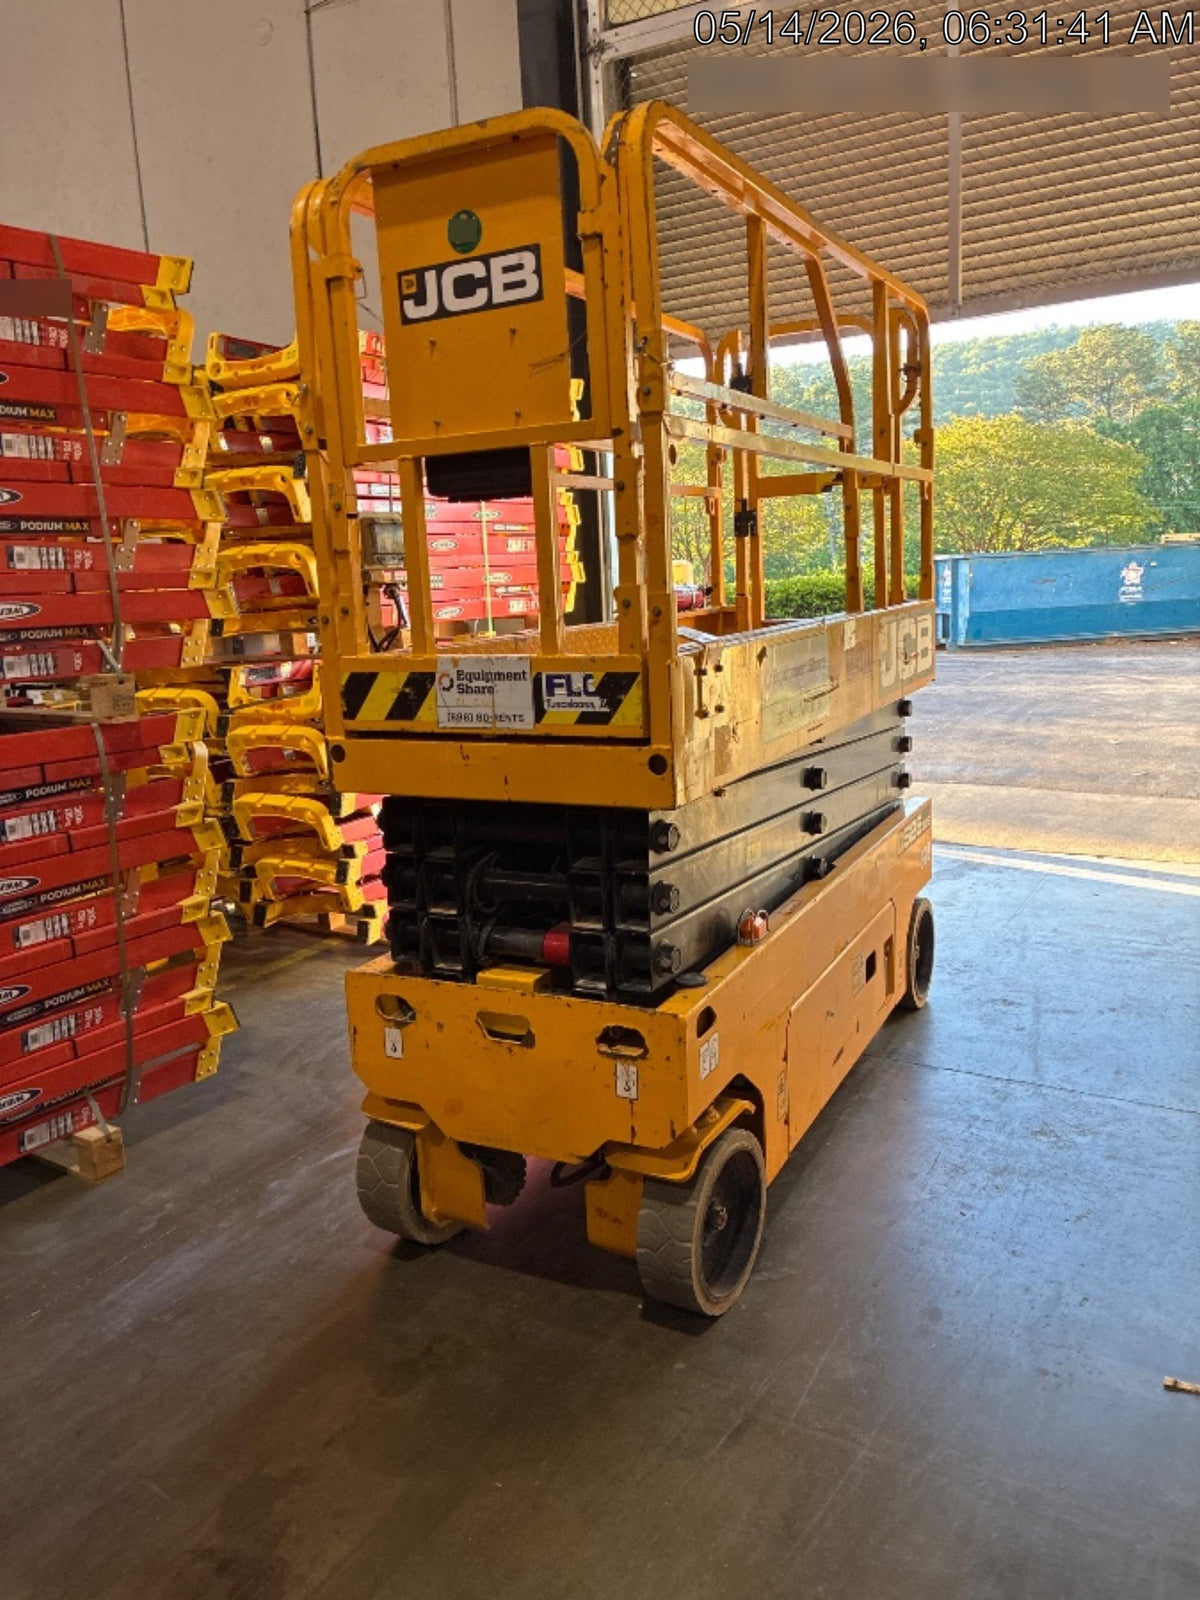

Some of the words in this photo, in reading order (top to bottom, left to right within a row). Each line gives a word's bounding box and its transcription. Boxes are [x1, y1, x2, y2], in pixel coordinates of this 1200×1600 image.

[402, 250, 540, 319] JCB
[20, 521, 63, 531] PODIUM
[64, 521, 90, 531] MAX
[20, 629, 63, 640] PODIUM
[456, 669, 527, 683] Equipment
[456, 683, 495, 695] Share
[25, 783, 67, 799] PODIUM
[40, 884, 80, 903] PODIUM
[44, 986, 86, 1009] PODIUM
